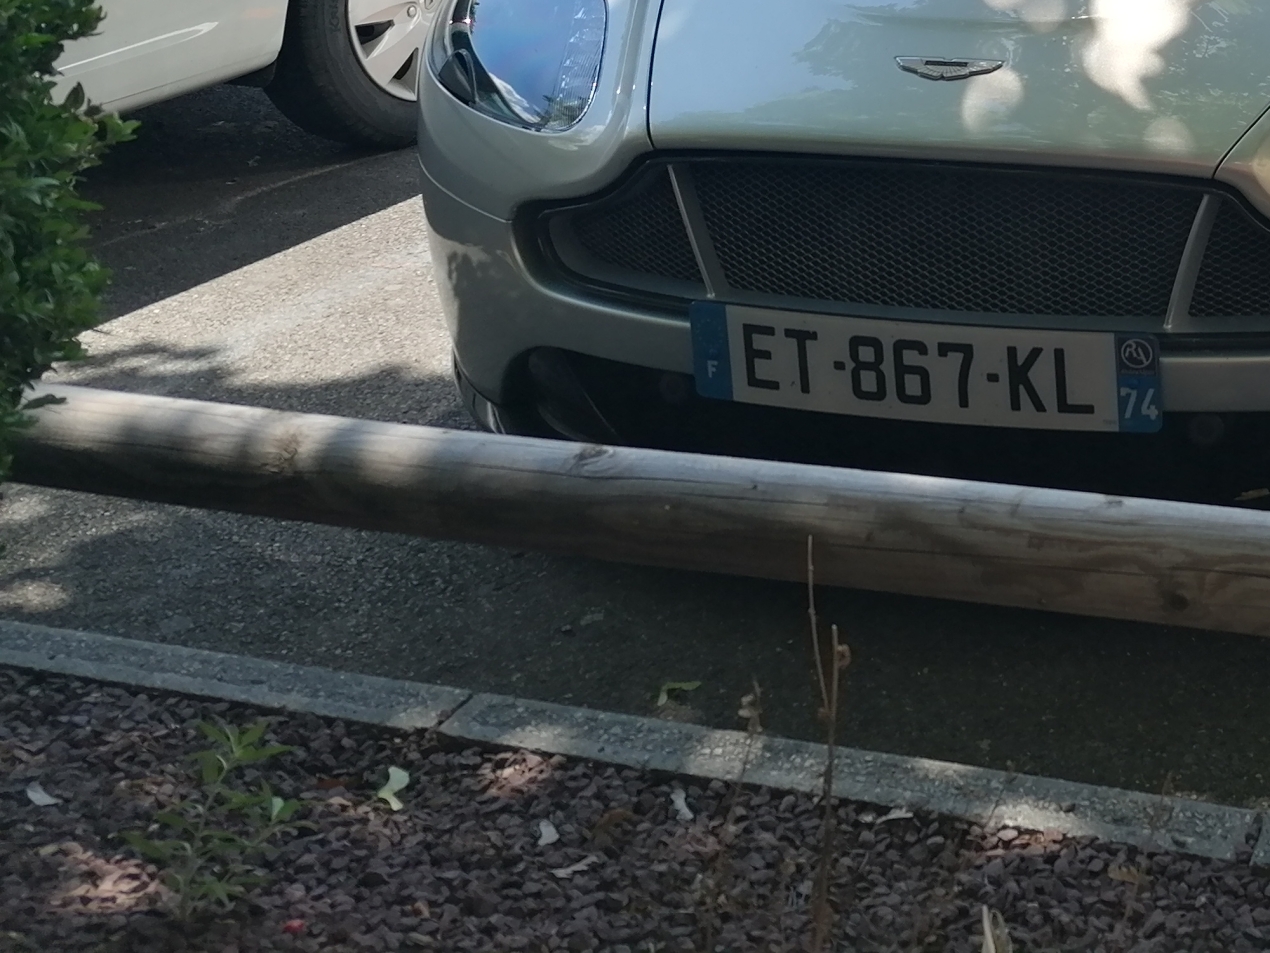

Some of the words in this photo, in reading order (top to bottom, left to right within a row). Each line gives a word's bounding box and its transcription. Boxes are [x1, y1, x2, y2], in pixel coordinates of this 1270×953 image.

[707, 360, 719, 379] F
[742, 322, 1095, 415] ET-867-KL
[1120, 387, 1159, 421] 74
